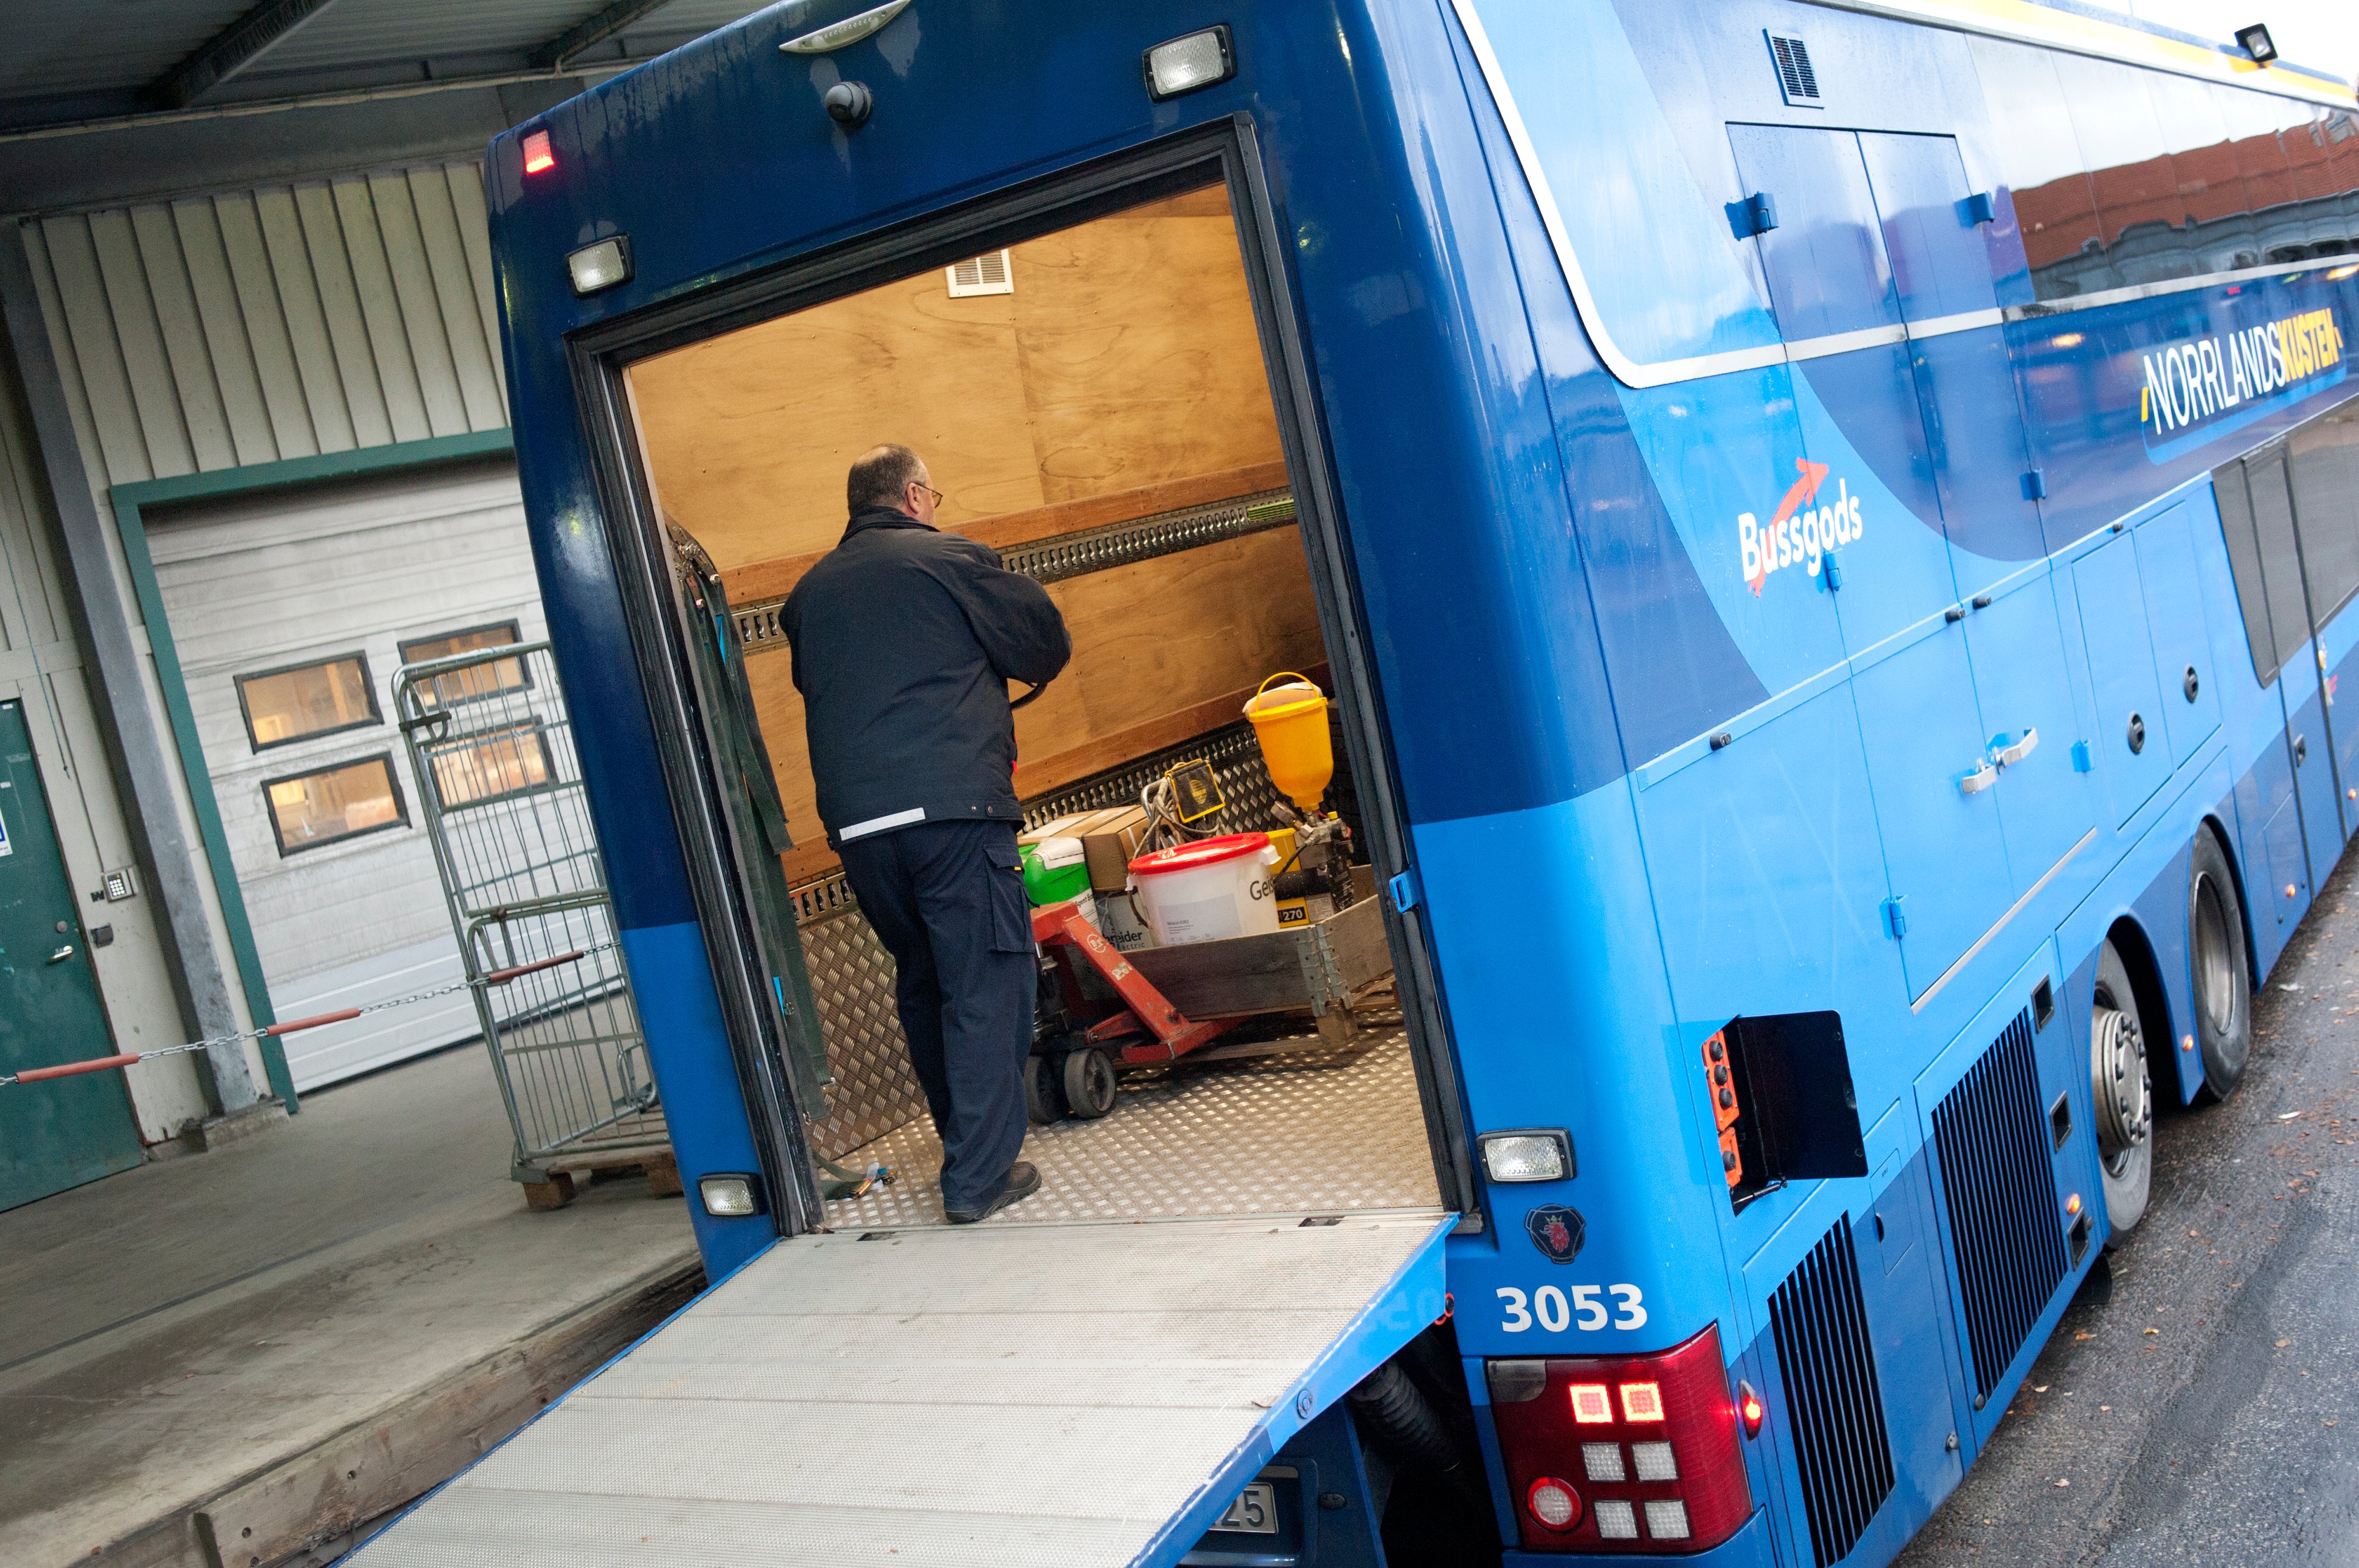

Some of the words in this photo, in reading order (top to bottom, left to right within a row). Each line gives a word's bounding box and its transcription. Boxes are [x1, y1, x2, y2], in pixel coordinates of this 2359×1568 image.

[1738, 478, 1863, 582] Bussgods
[1283, 909, 1303, 921] 270
[1120, 942, 1145, 951] ectric
[1496, 1283, 1647, 1333] 3053
[1214, 1490, 1265, 1527] 25
